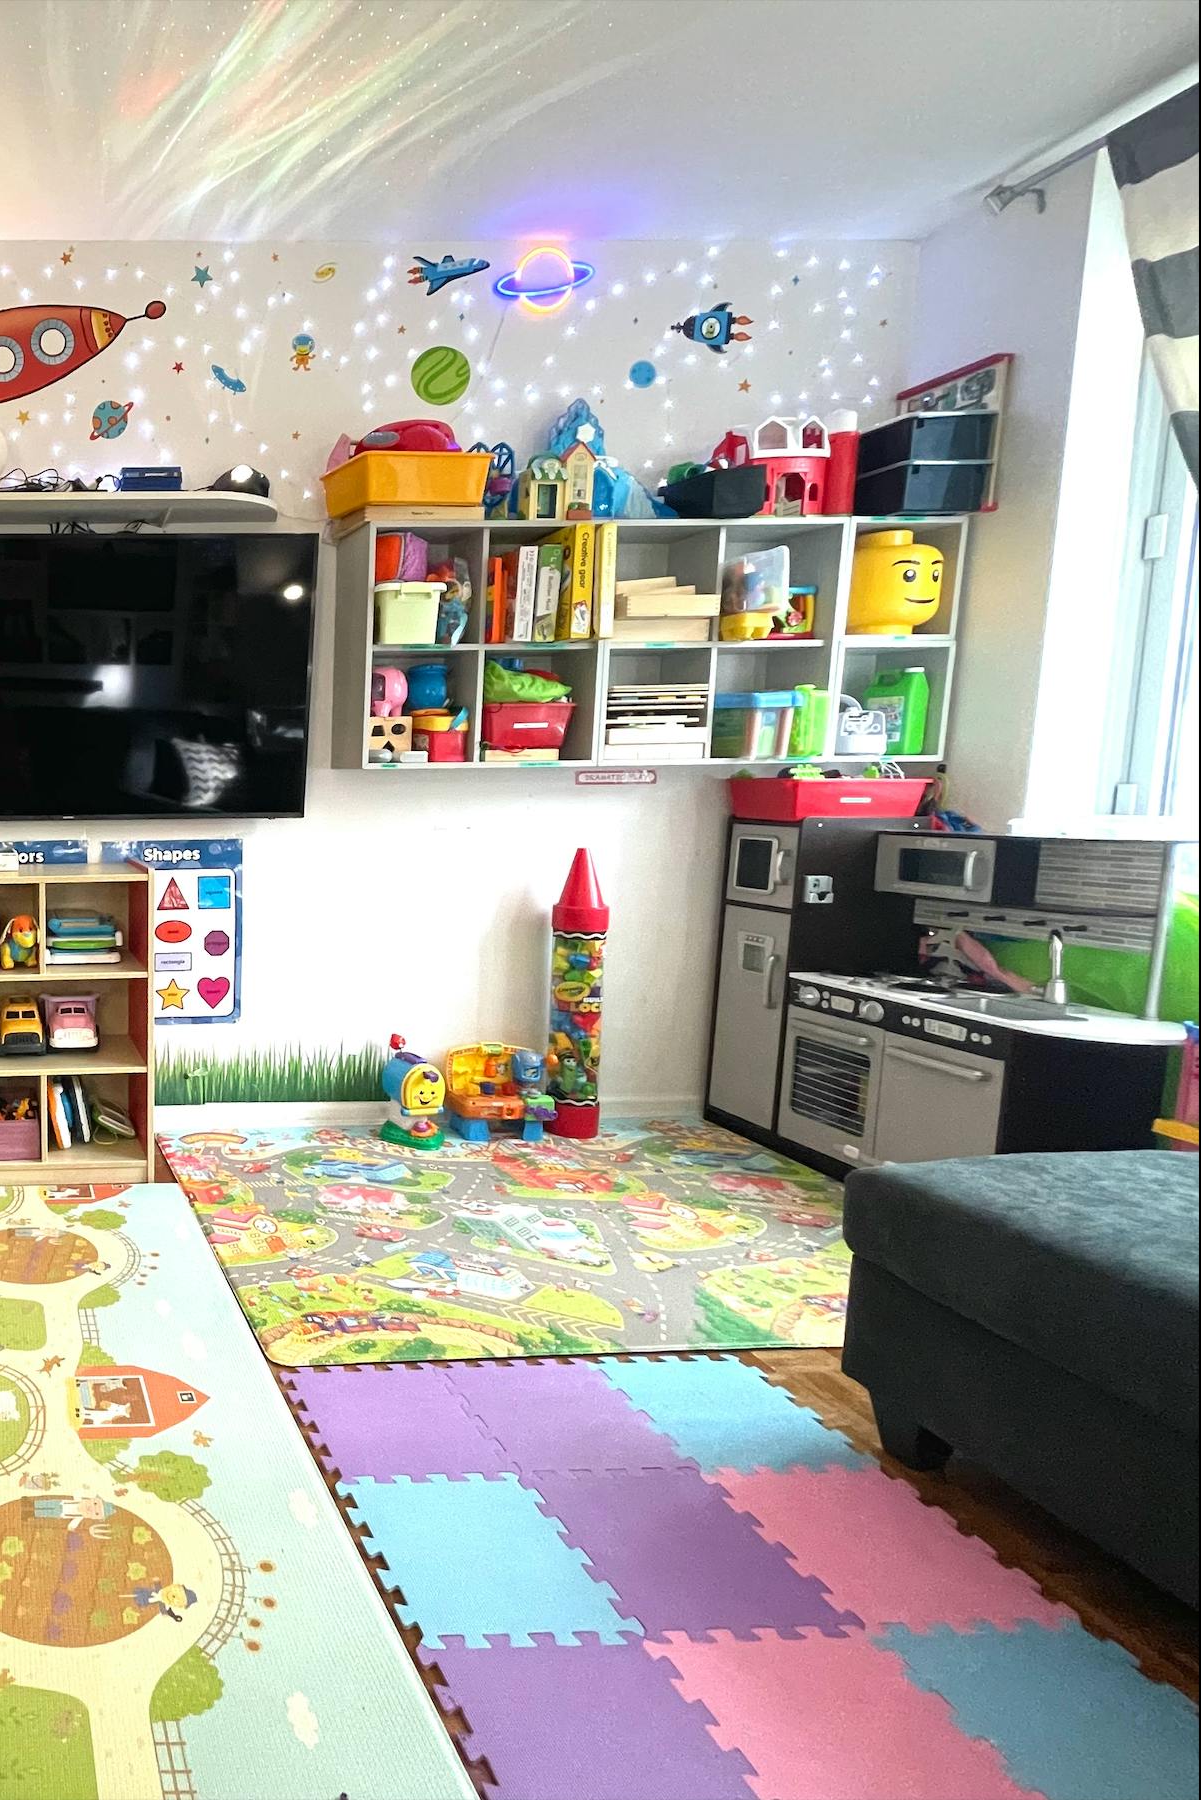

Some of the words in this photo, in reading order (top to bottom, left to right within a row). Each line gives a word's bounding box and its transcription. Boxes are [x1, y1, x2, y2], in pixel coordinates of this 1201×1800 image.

[579, 532, 590, 567] Creative
[578, 567, 586, 589] gear
[18, 852, 45, 864] ors
[143, 848, 201, 863] Shapes
